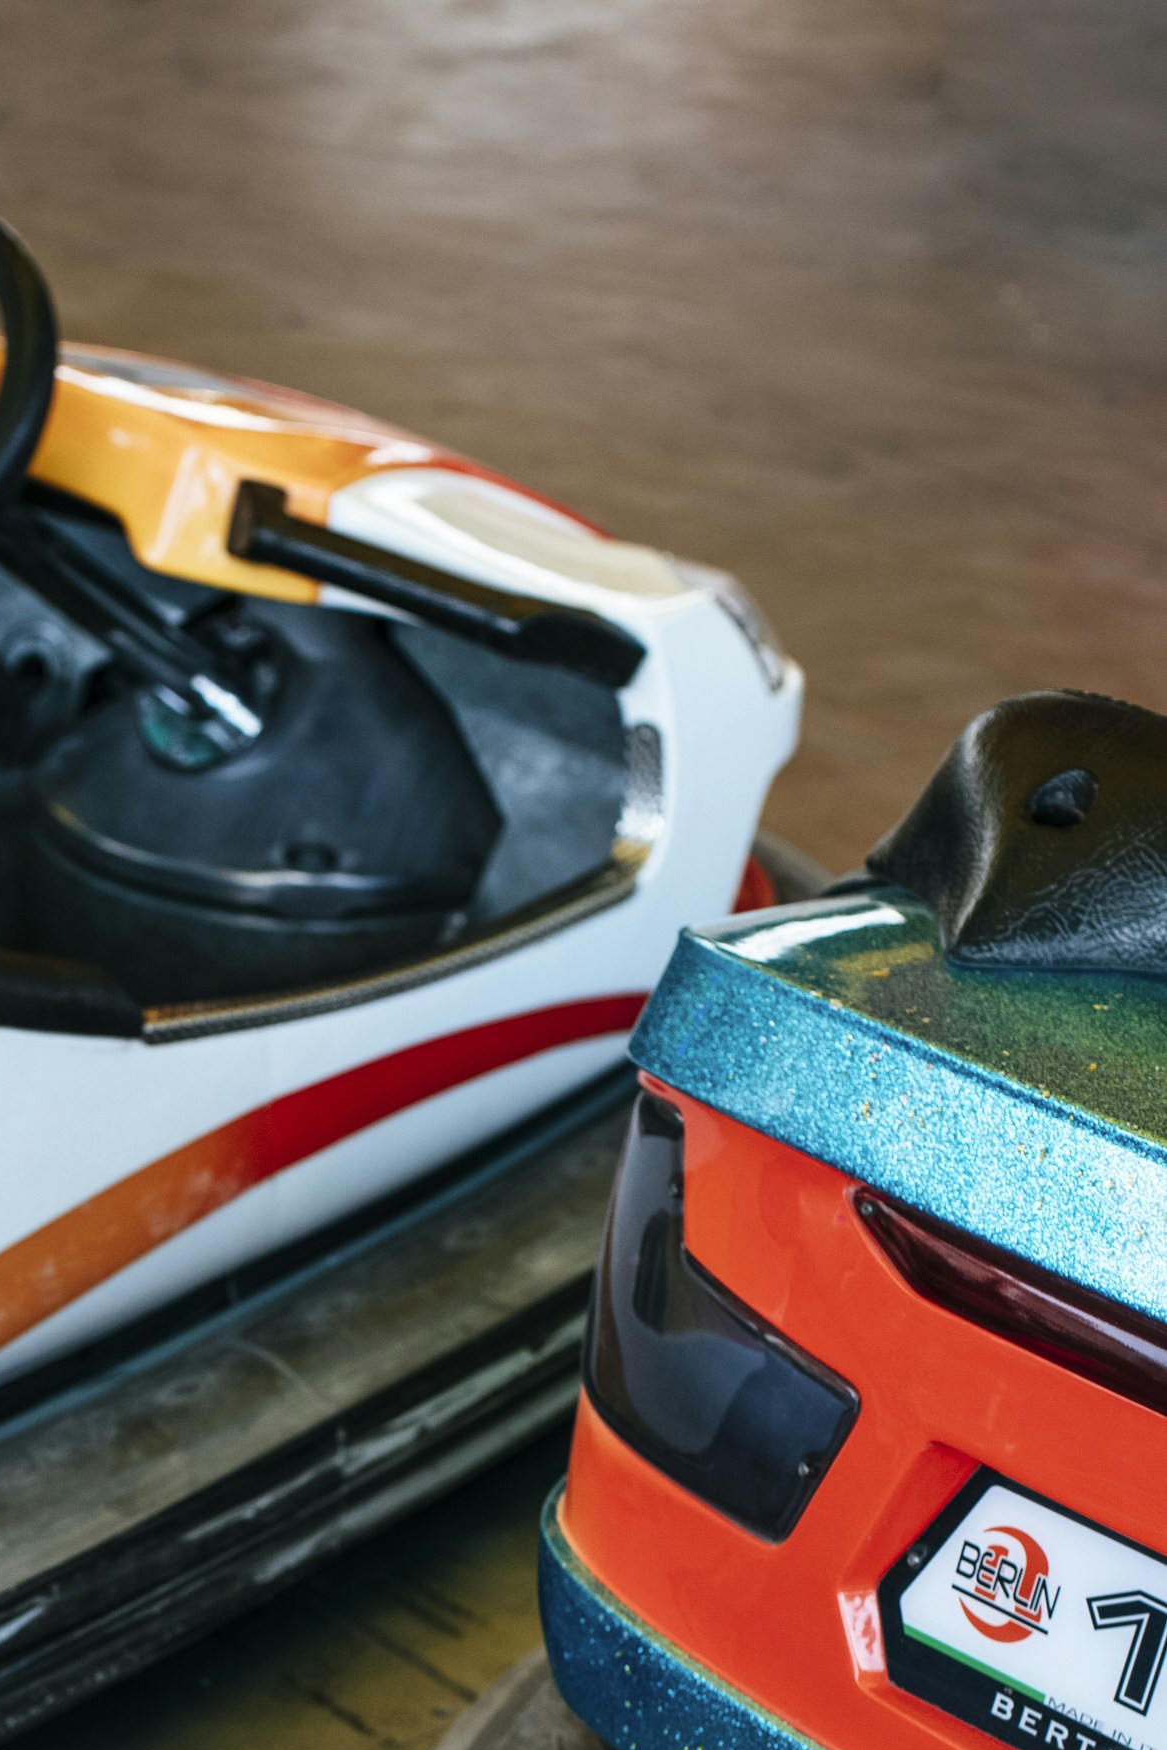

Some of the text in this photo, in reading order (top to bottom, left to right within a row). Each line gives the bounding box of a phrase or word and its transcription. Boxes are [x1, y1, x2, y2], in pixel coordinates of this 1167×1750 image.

[955, 1540, 1061, 1620] BERLIN
[1086, 1590, 1167, 1717] 1
[1048, 1696, 1106, 1733] MADE
[1112, 1729, 1132, 1748] IN
